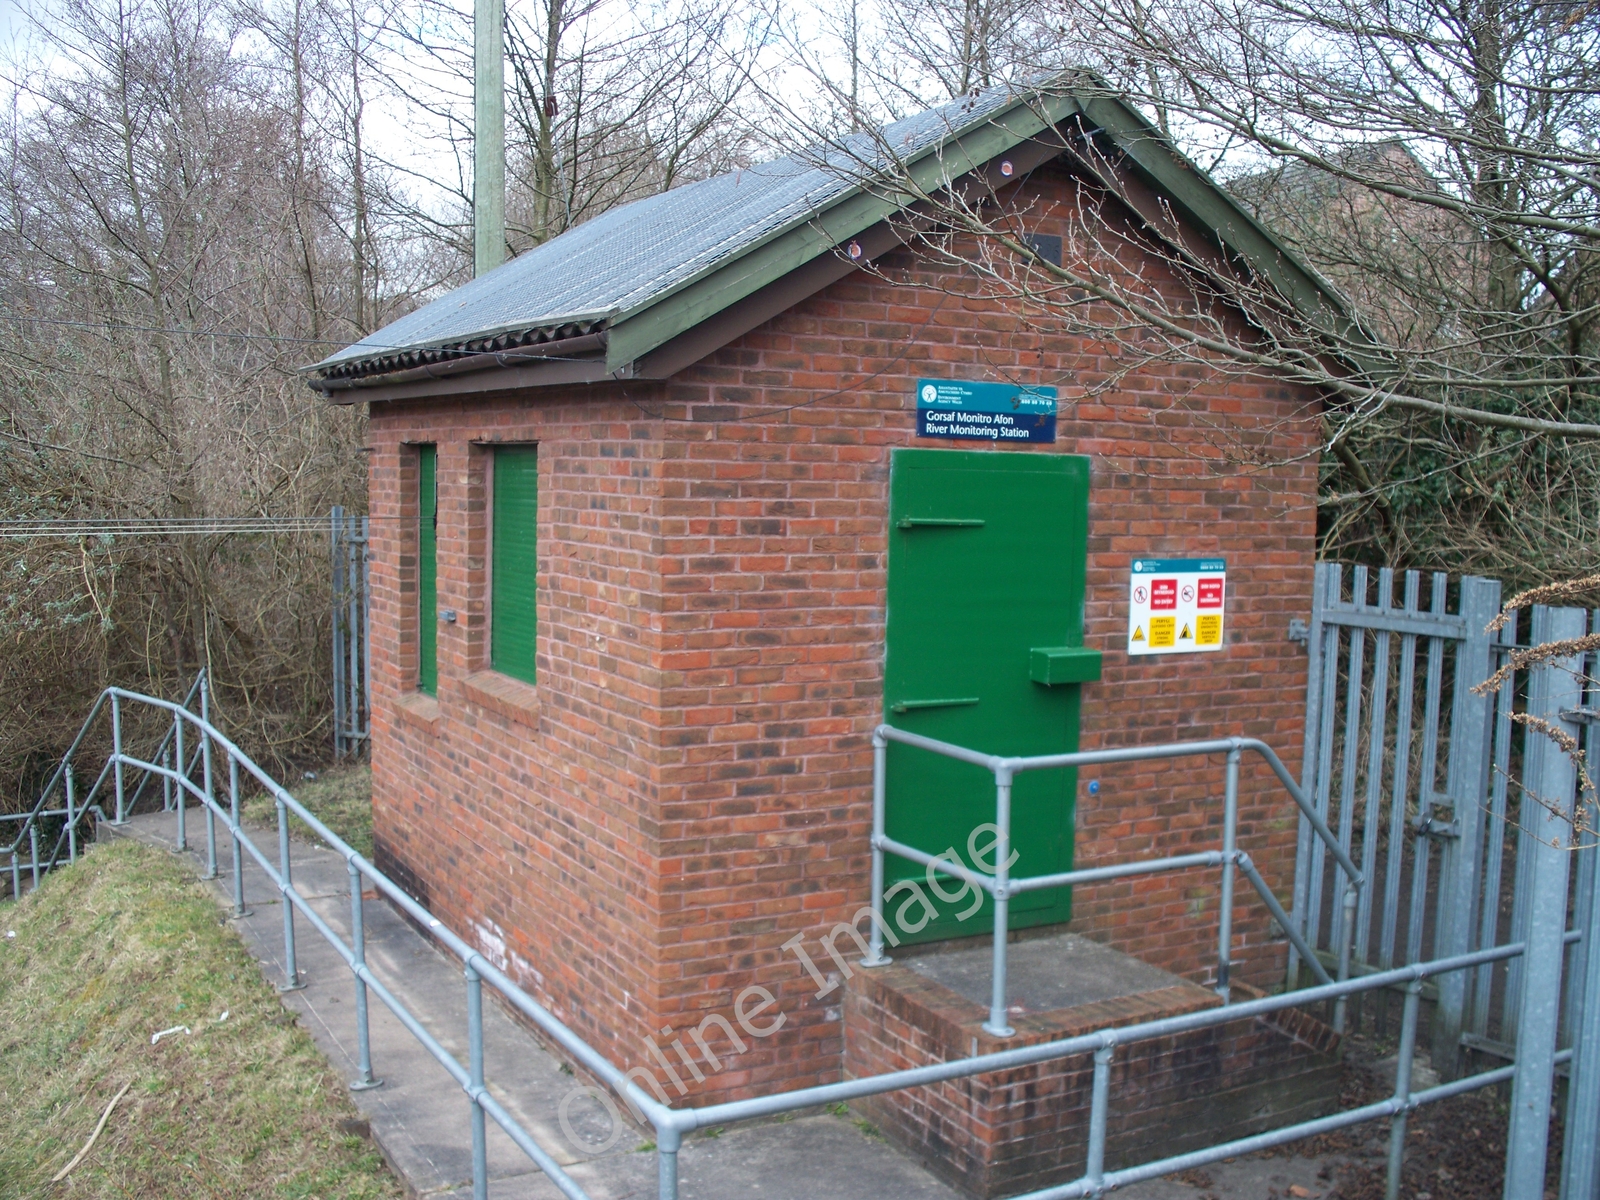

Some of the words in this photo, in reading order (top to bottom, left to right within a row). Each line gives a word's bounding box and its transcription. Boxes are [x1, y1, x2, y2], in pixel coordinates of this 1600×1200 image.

[926, 410, 955, 421] Gorsaf
[957, 412, 992, 423] Monitro
[993, 414, 1014, 425] Afon
[926, 423, 948, 434] River
[949, 424, 998, 439] Monitoring
[1000, 427, 1029, 438] Station
